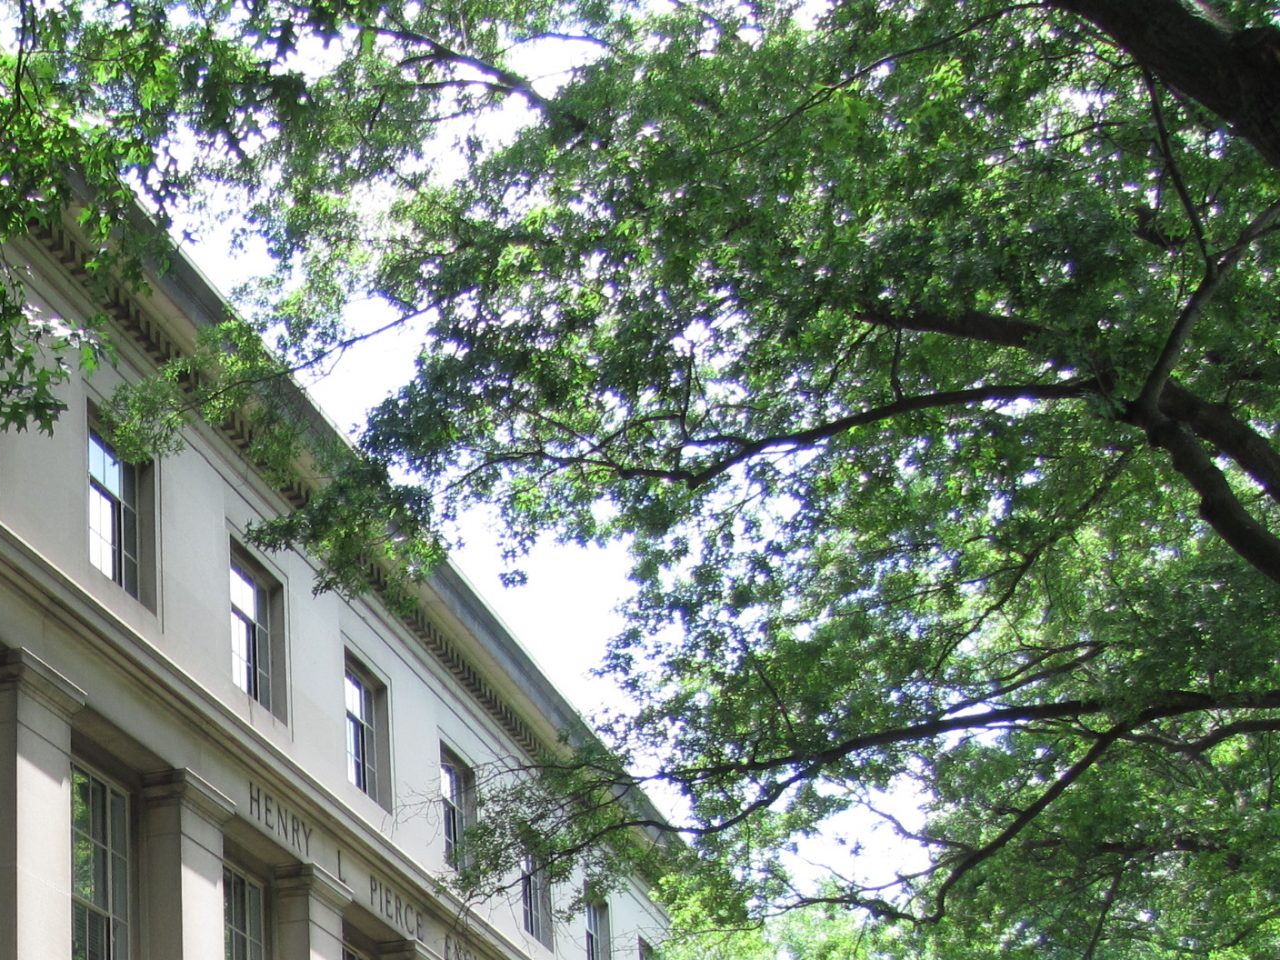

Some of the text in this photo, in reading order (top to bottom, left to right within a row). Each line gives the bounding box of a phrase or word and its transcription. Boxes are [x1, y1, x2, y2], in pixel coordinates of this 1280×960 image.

[249, 781, 313, 857] HENRY
[337, 850, 347, 884] L
[369, 875, 425, 942] PIERCE
